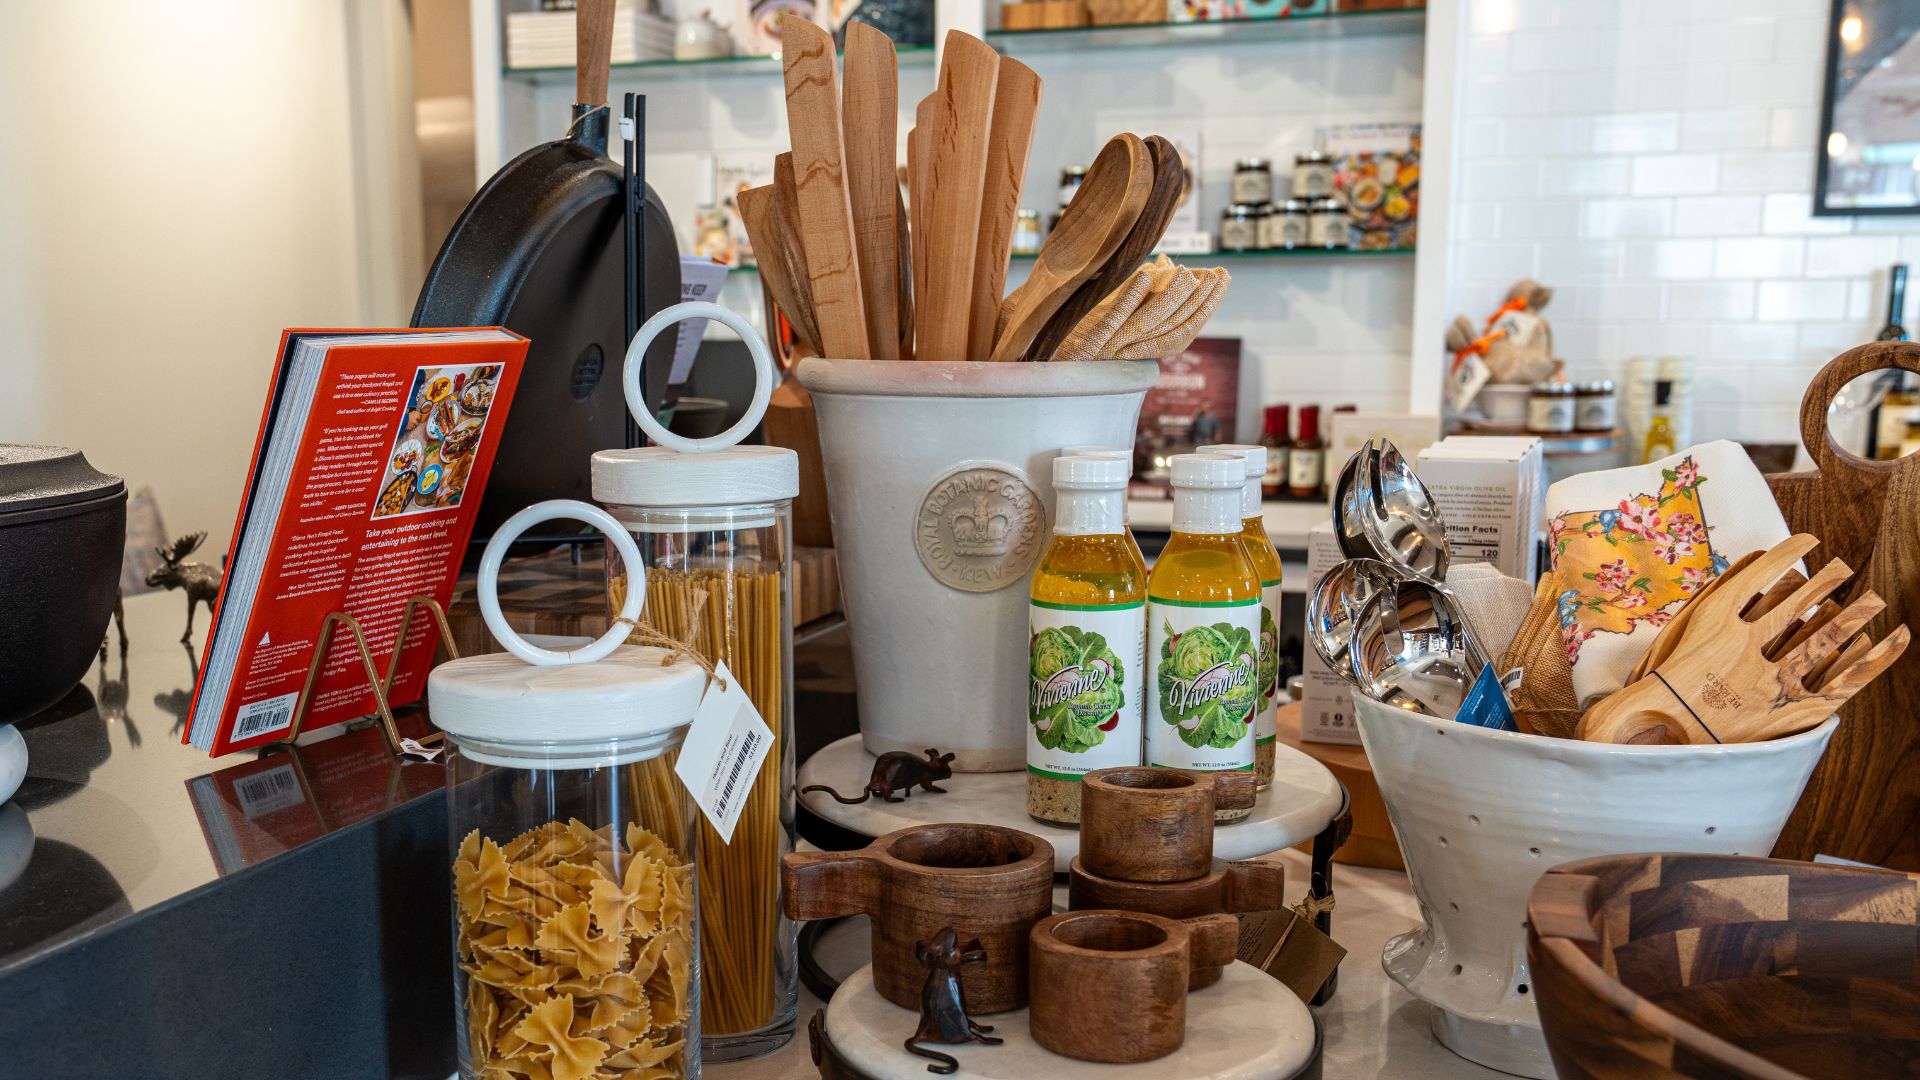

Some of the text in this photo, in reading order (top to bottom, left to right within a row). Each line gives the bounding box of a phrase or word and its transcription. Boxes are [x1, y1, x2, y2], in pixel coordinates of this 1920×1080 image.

[927, 474, 999, 516] BOTANIC
[366, 529, 380, 537] Take
[381, 528, 396, 536] your
[396, 524, 420, 532] outdoor
[421, 520, 445, 528] cooking
[1472, 526, 1498, 534] Facts
[361, 538, 399, 550] entertaining
[432, 529, 447, 538] level.
[1481, 549, 1498, 558] 120
[1031, 665, 1107, 715] Vivienne
[1170, 661, 1249, 716] Vivienne
